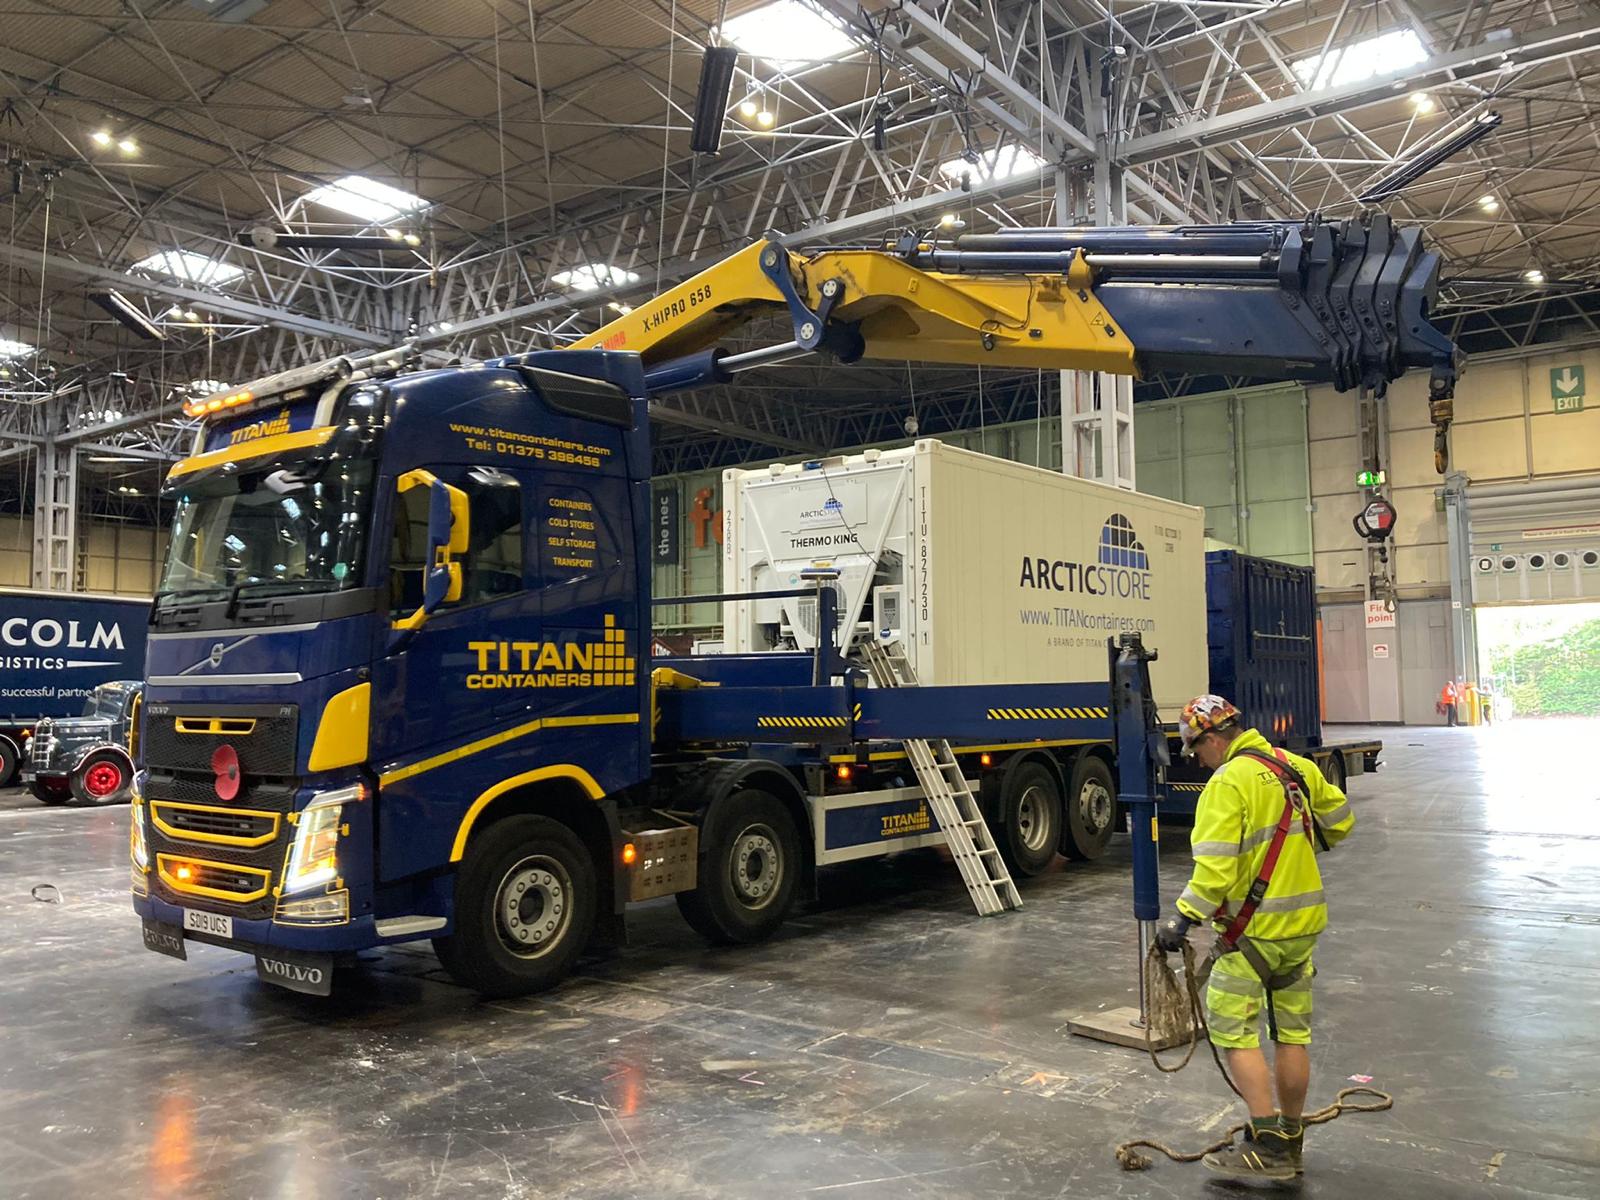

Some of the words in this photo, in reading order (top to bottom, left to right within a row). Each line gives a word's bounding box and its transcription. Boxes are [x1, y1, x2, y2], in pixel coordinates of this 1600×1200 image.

[642, 299, 685, 333] X-HIPRO
[689, 284, 712, 307] 658
[1557, 396, 1580, 410] EXIT
[231, 421, 274, 444] TITAN
[450, 423, 612, 456] www.titancontainers.com
[465, 437, 492, 451] Tel:
[496, 442, 545, 458] 01375
[549, 498, 592, 511] CONTAINERS
[660, 496, 669, 525] nec
[548, 518, 568, 528] COLD
[570, 520, 595, 530] STORES
[548, 537, 564, 547] SELF
[566, 538, 597, 549] STORAGE
[658, 529, 669, 556] the
[790, 536, 832, 548] THERMO
[833, 533, 858, 545] KING
[553, 557, 593, 568] TRANSPORT
[1020, 556, 1152, 600] ARCTICSTORE
[1368, 614, 1393, 624] point
[468, 641, 593, 671] TITAN
[466, 673, 592, 689] CONTAINERS
[1, 686, 55, 697] successful
[881, 813, 917, 829] TITAN
[260, 957, 322, 984] VOLVO
